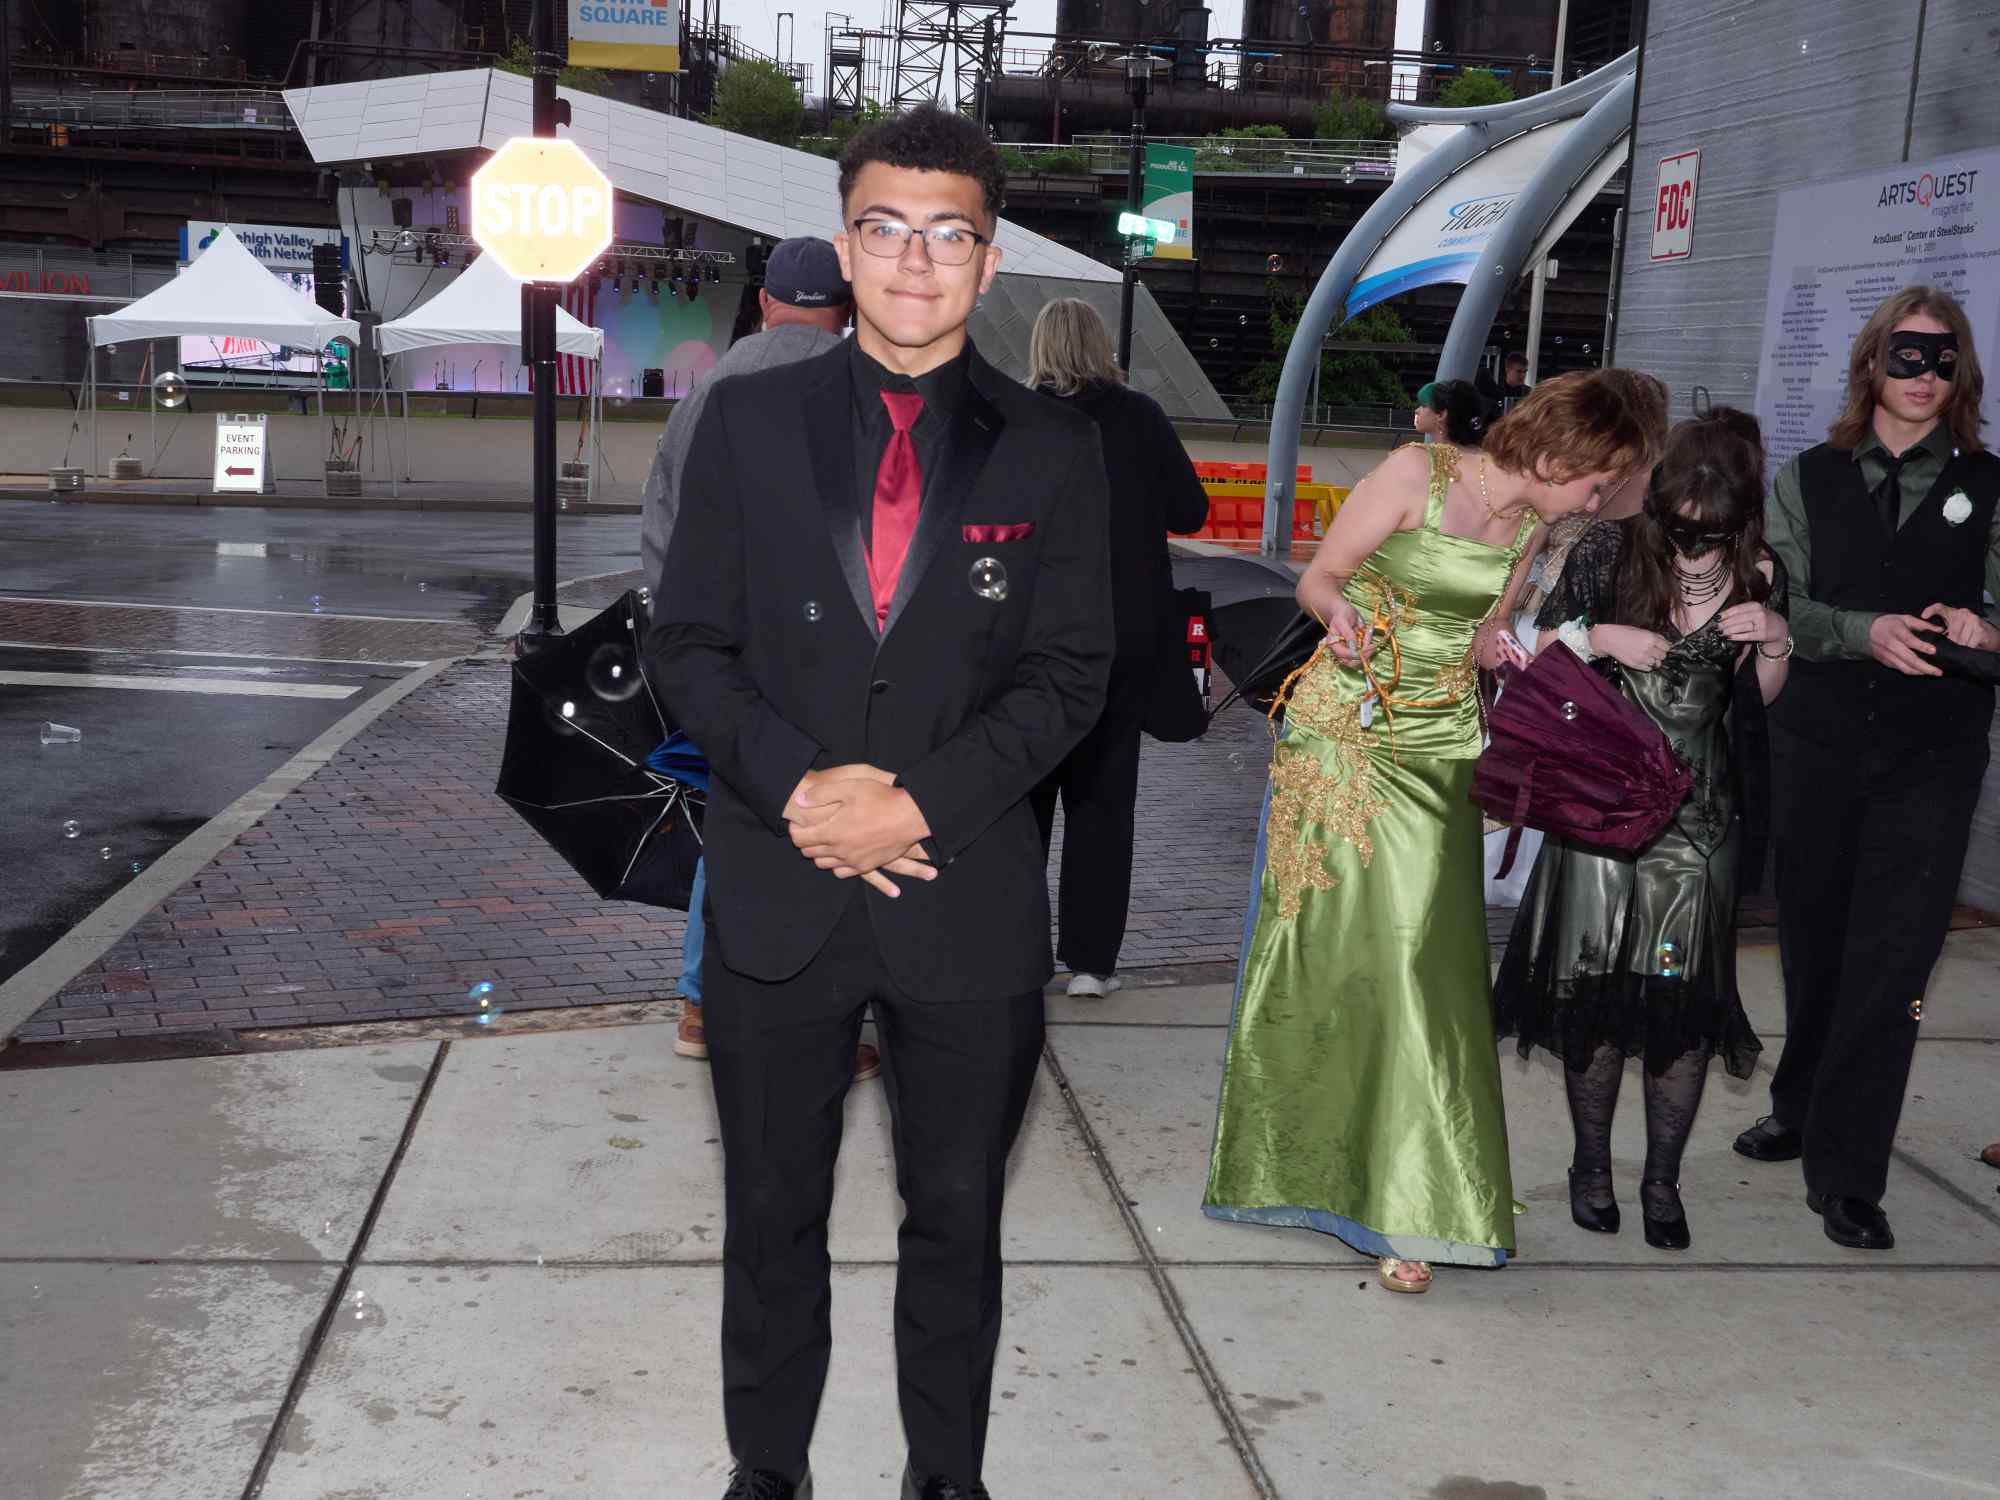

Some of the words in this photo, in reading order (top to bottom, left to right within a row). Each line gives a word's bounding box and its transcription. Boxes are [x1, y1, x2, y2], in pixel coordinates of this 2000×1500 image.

[579, 6, 668, 26] SQUARE
[1877, 170, 1978, 208] ARTSQUEST
[484, 183, 601, 237] STOP
[1440, 199, 1515, 232] HIGH
[1656, 180, 1691, 233] FDC
[238, 232, 273, 247] ehigh
[274, 233, 315, 248] Valley
[250, 246, 272, 259] alth
[274, 249, 313, 260] Netwo
[226, 433, 256, 443] EVENT
[220, 446, 260, 456] PARKING
[1192, 623, 1205, 636] R
